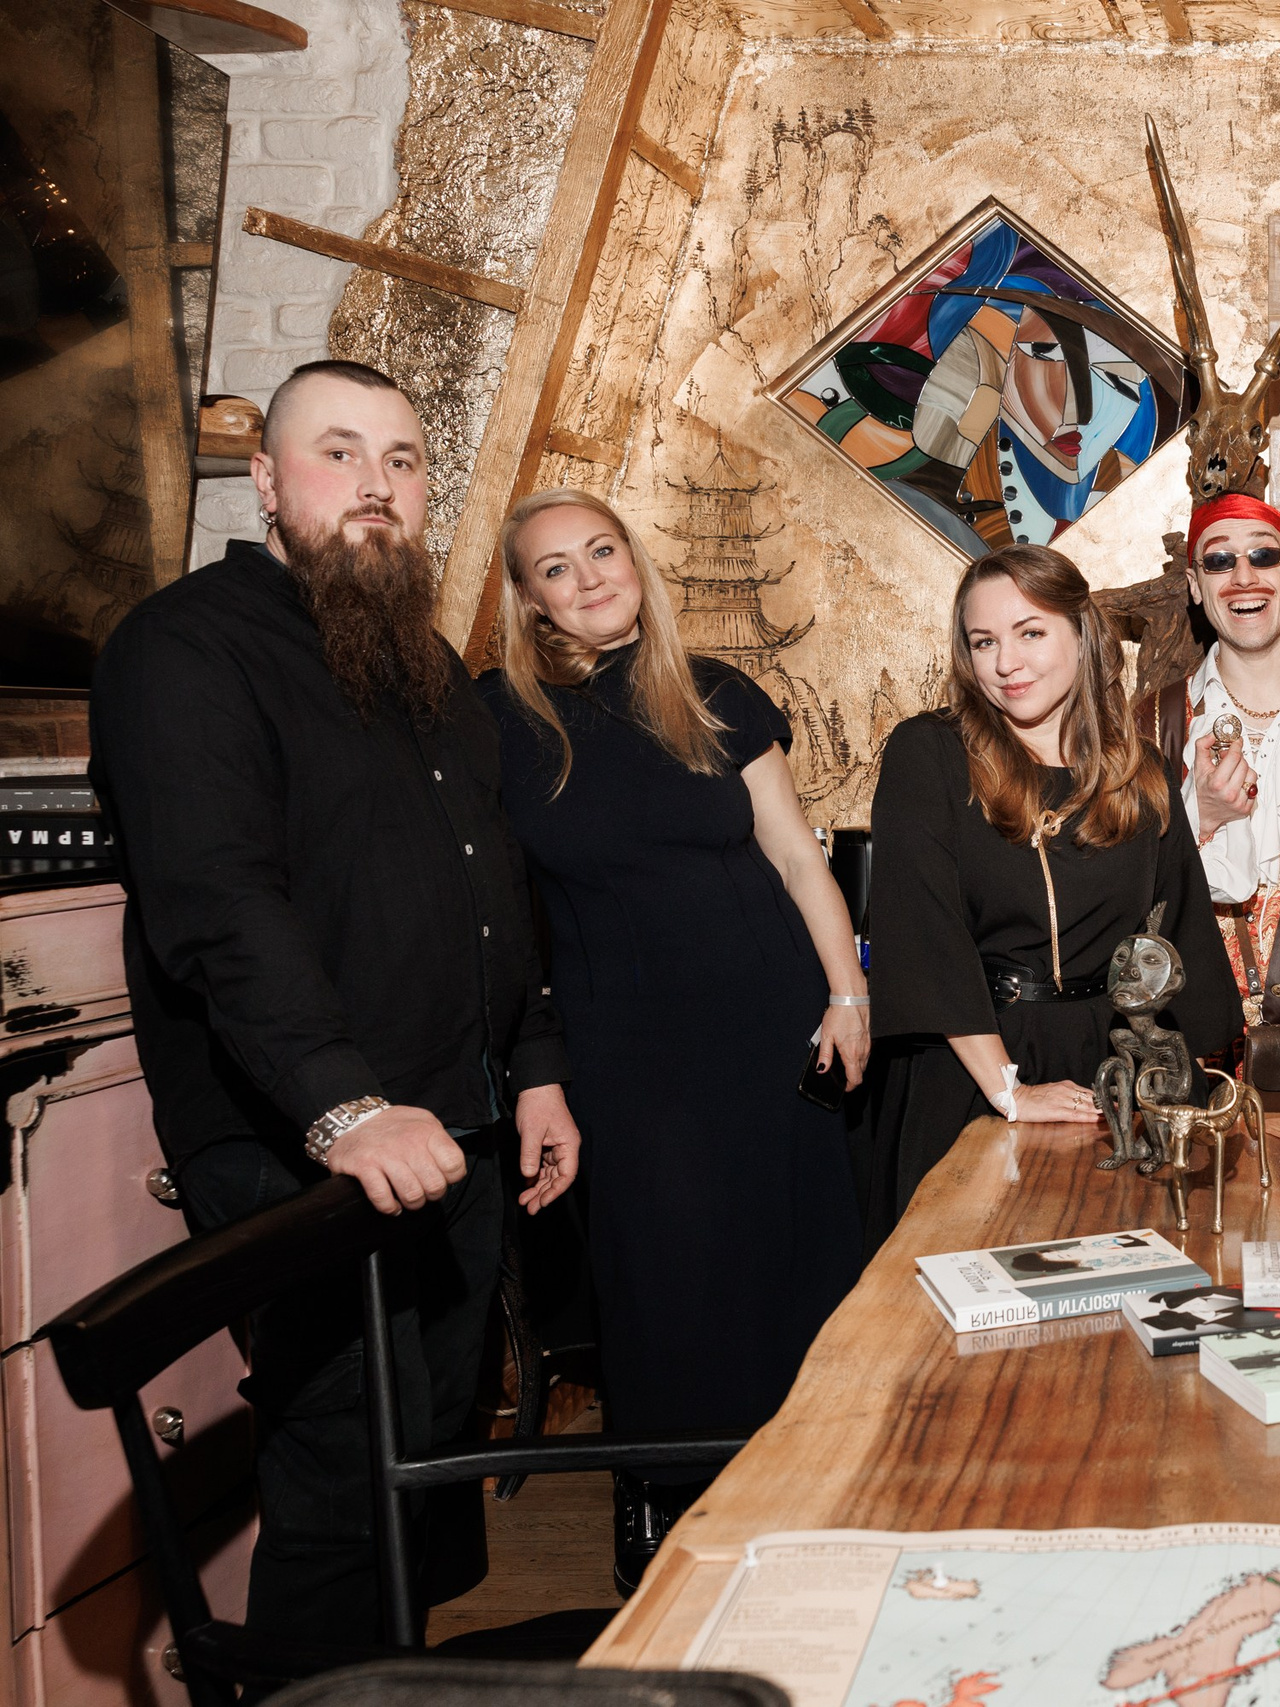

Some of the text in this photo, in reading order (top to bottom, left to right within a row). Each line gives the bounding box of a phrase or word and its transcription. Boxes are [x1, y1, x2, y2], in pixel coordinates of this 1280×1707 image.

[970, 1289, 1147, 1328] ДЗОГУТИ И ЯПОНИЯ
